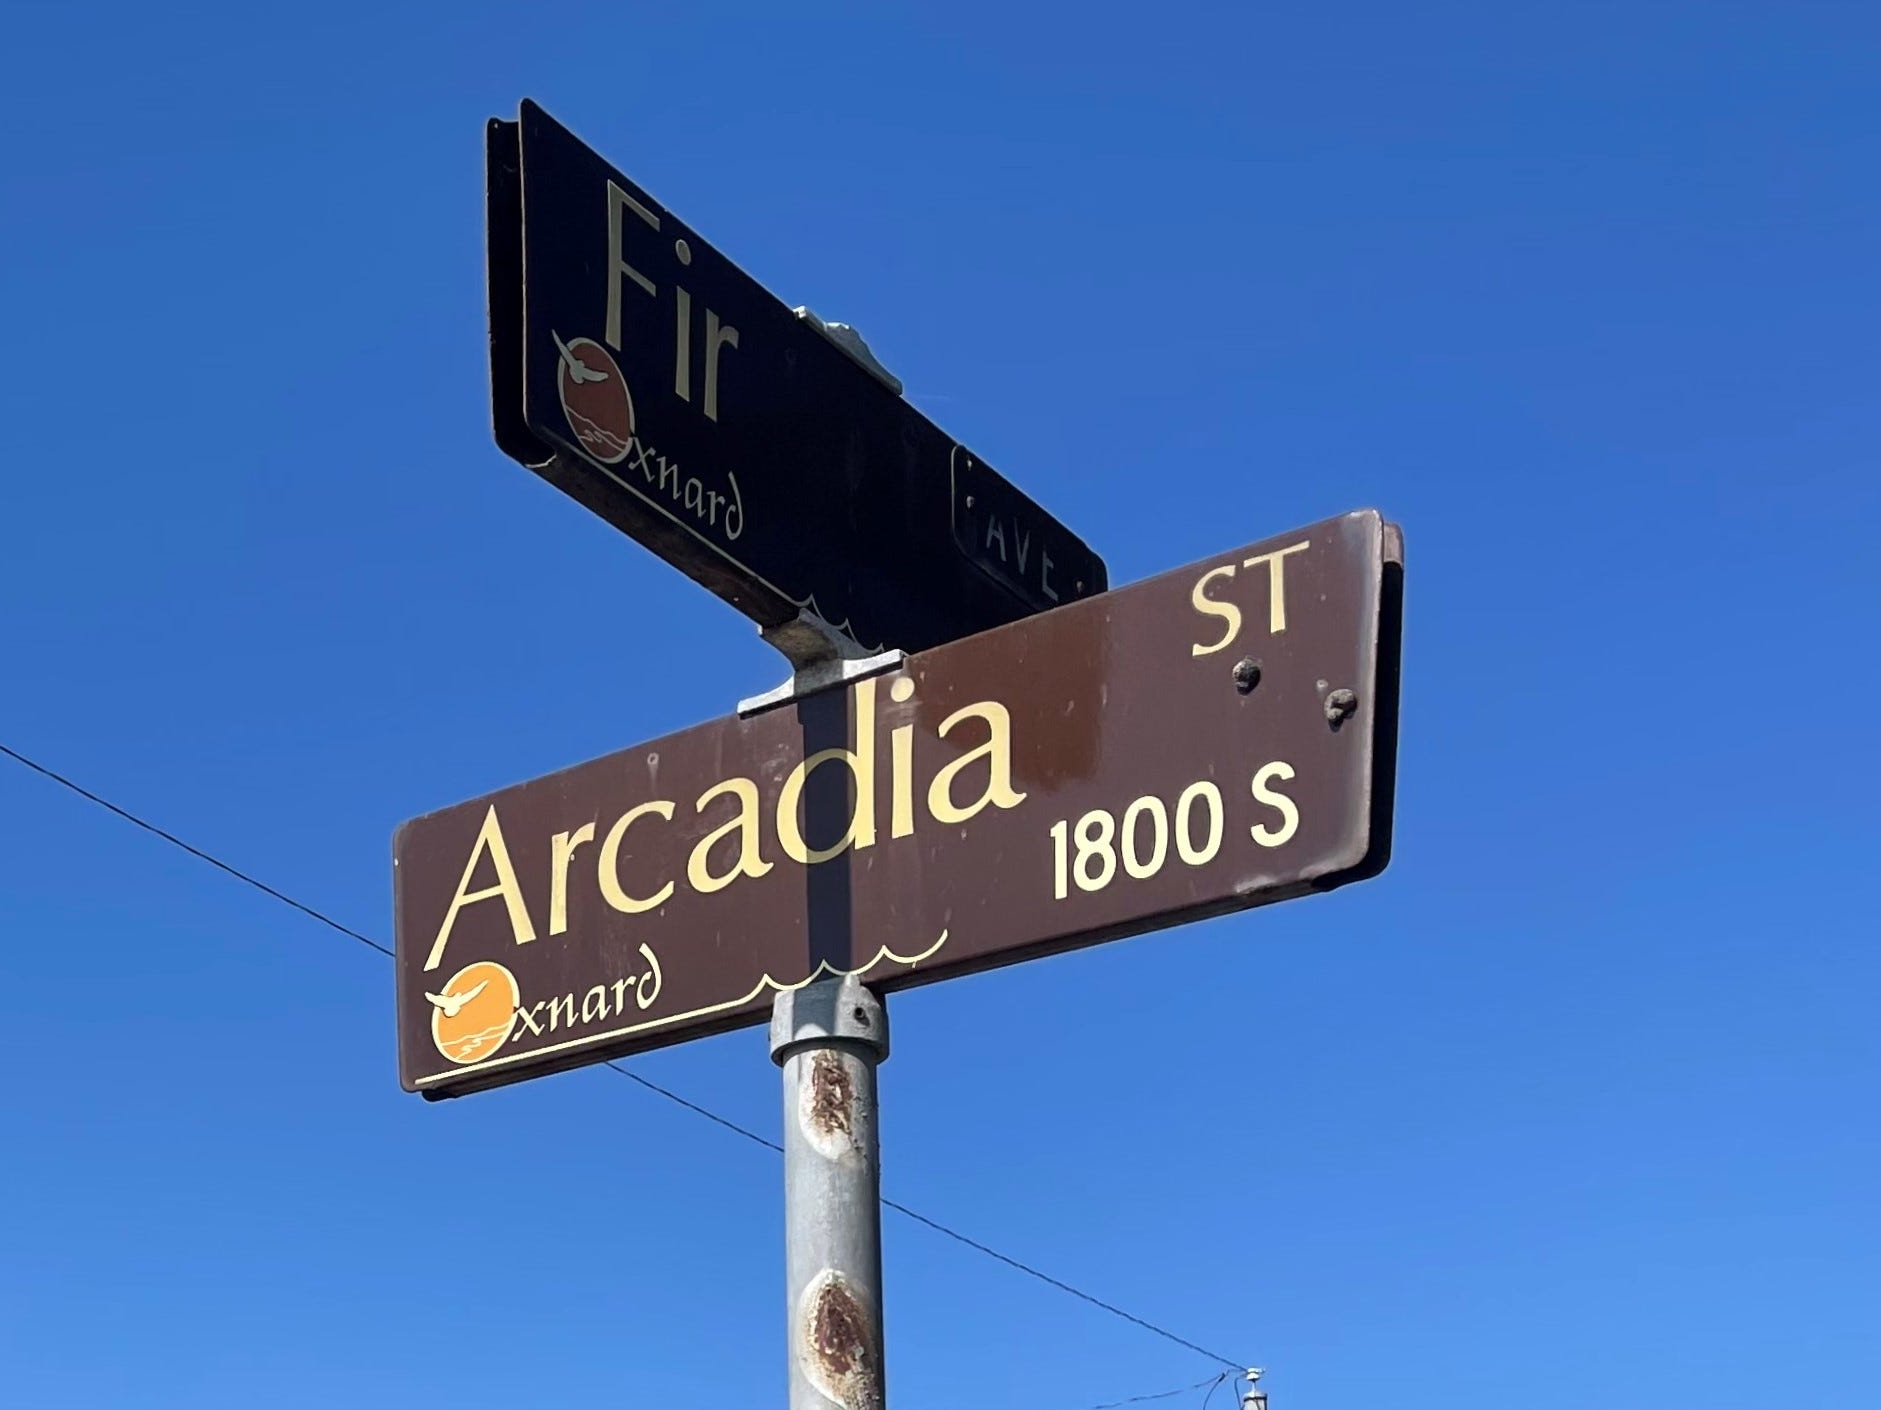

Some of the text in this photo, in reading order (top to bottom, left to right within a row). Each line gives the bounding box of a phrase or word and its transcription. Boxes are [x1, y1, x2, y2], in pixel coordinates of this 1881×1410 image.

[556, 335, 744, 541] Oxnard
[605, 178, 1059, 602] Fir AVE
[423, 540, 1310, 972] Arcadia ST
[1050, 761, 1300, 900] 1800 S
[429, 942, 662, 1065] Oxnard
